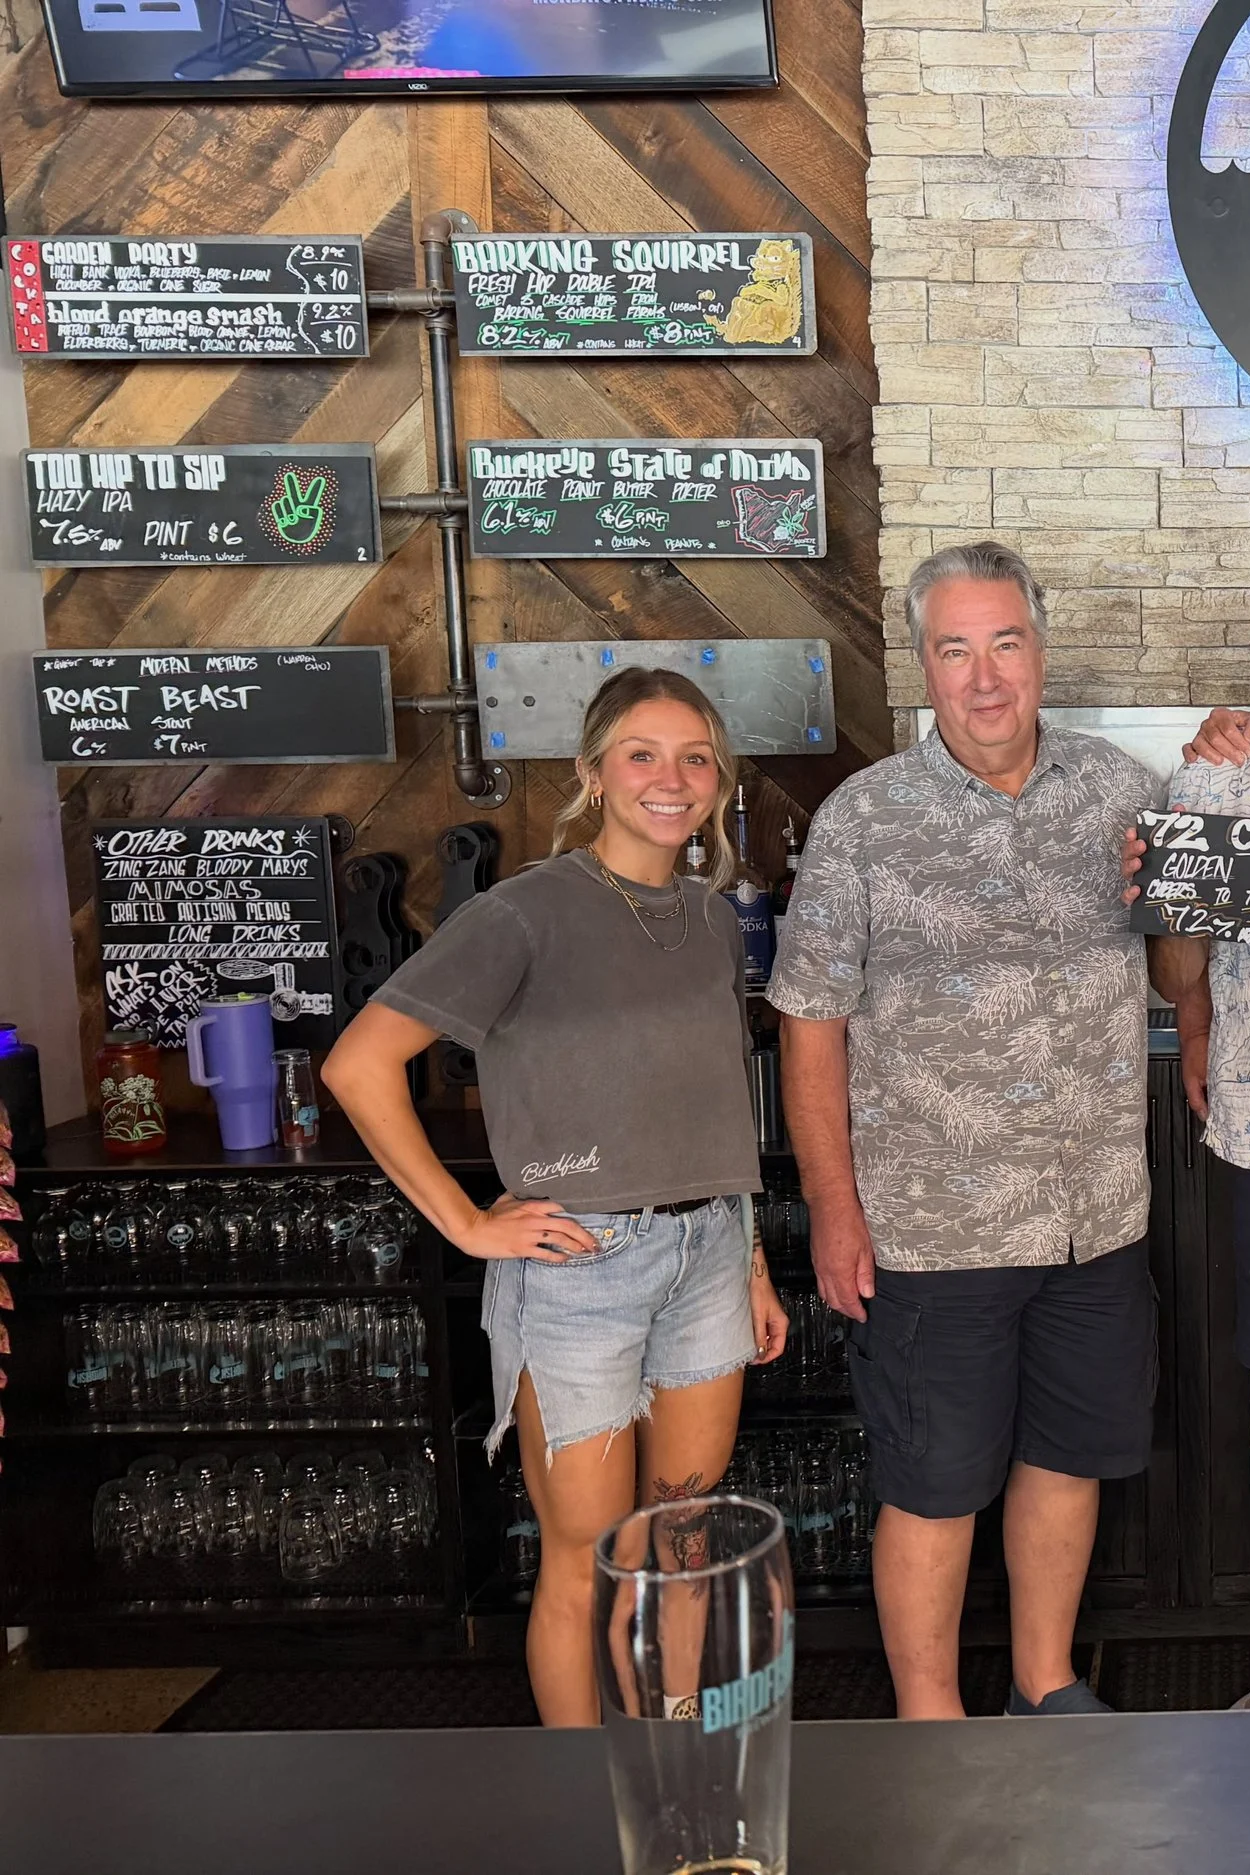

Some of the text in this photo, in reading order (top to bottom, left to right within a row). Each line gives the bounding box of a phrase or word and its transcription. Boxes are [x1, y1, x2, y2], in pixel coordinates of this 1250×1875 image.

[42, 242, 197, 266] GARDEN PARTY
[453, 240, 751, 275] BARKING SQUIRREL
[468, 273, 657, 294] FRESH HOP DOUBLE IPA
[47, 300, 284, 331] blood orange smash
[494, 305, 545, 321] BARKING
[556, 307, 616, 320] SQUIRREL
[482, 325, 713, 346] 8.2% PINT
[27, 454, 226, 491] TOO HIP TO SIP
[471, 447, 596, 479] Buckeye
[700, 453, 727, 480] of
[483, 479, 718, 500] CHOCOLATE PEANUT BUTTER PORTER
[37, 490, 134, 513] HAZY IPA
[484, 501, 530, 530] 6.1%
[635, 511, 665, 527] PINT
[39, 518, 104, 545] 7.5%
[144, 521, 194, 546] PINT
[357, 547, 367, 561] 2
[206, 655, 258, 672] METHODS
[42, 684, 262, 714] ROAST BEAST
[70, 716, 194, 731] AMERICAN STOUT
[72, 734, 208, 756] 6% $7 PINT
[108, 828, 285, 855] OTHER DRINKS
[104, 858, 308, 878] ZING ZANG BLOODY MARYS
[1162, 852, 1234, 883] GOLDEN
[128, 880, 262, 900] MIMOSAS
[1215, 886, 1231, 905] TO
[111, 902, 291, 922] CRAFTED ARTISAN MEADS
[168, 925, 301, 943] LONG DRINKS
[741, 921, 768, 932] ODKA
[106, 961, 158, 1000] ASK
[160, 960, 184, 986] ON
[175, 985, 209, 1012] PULL
[521, 1146, 600, 1183] Birdfish
